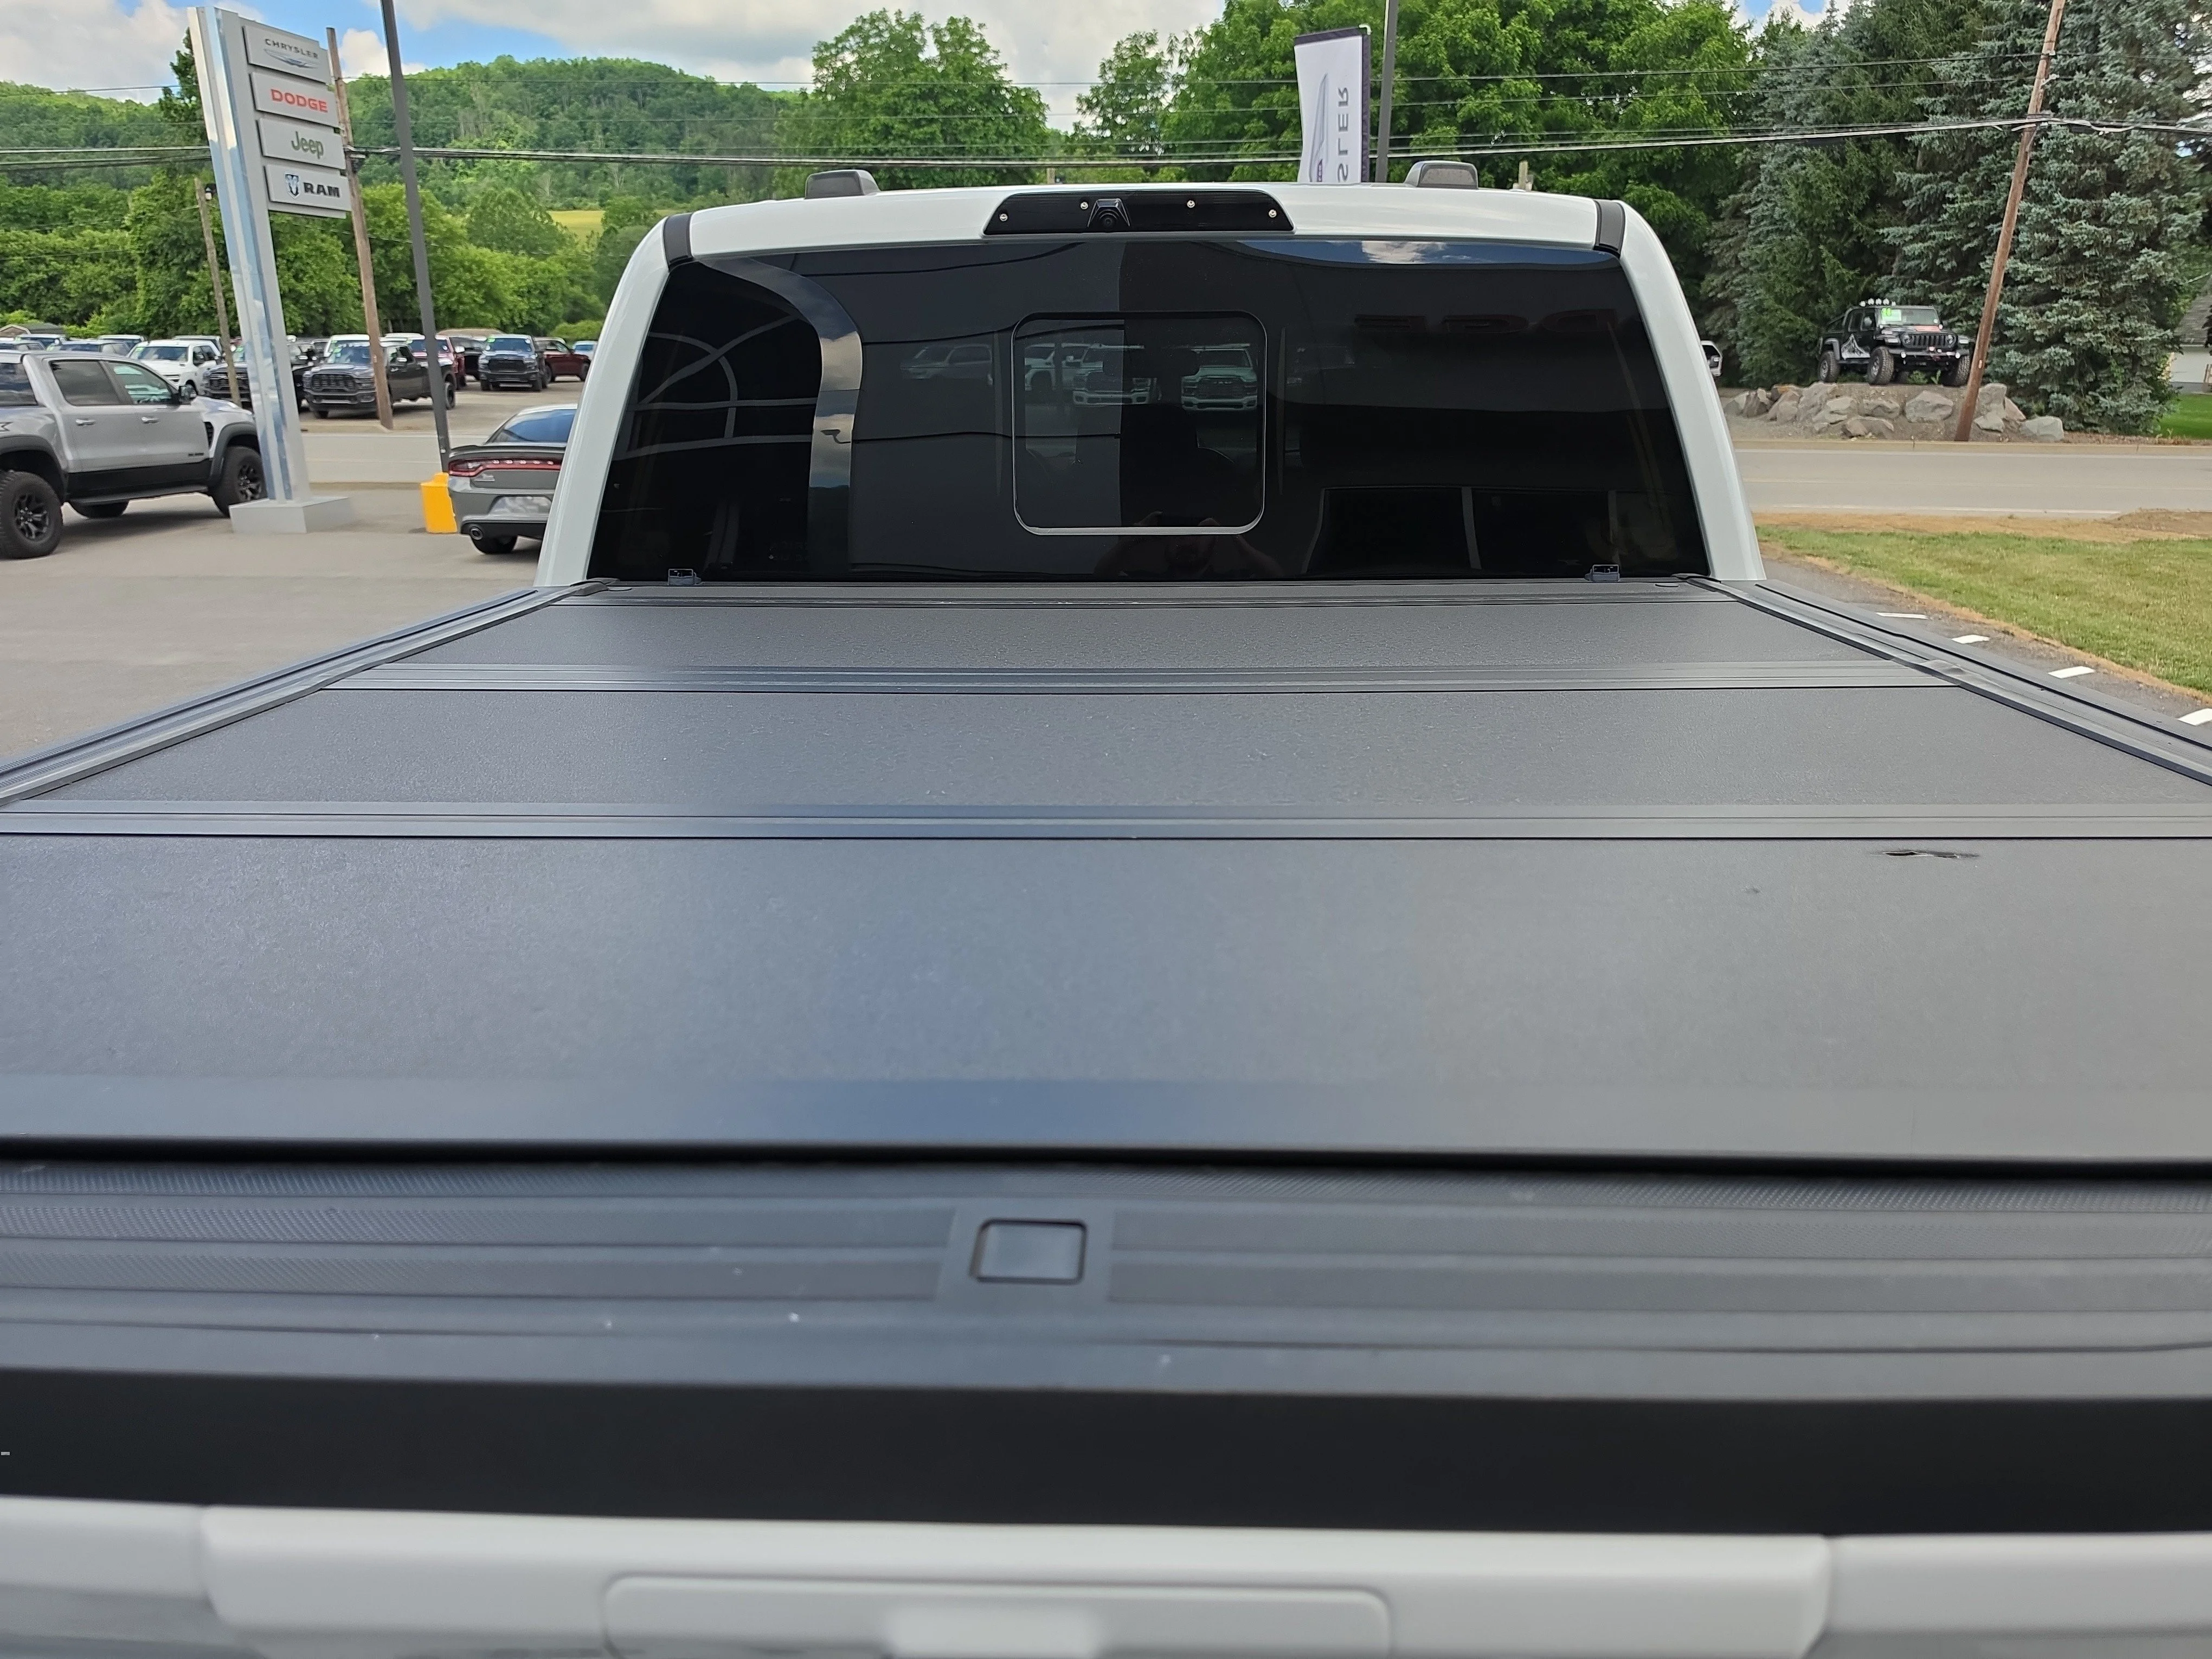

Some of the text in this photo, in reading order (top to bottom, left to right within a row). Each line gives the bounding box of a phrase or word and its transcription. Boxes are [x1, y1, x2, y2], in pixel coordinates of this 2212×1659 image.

[265, 38, 318, 59] CHRYSLER
[271, 89, 328, 112] DODGE
[291, 131, 324, 159] Jeep
[303, 182, 340, 198] RAM
